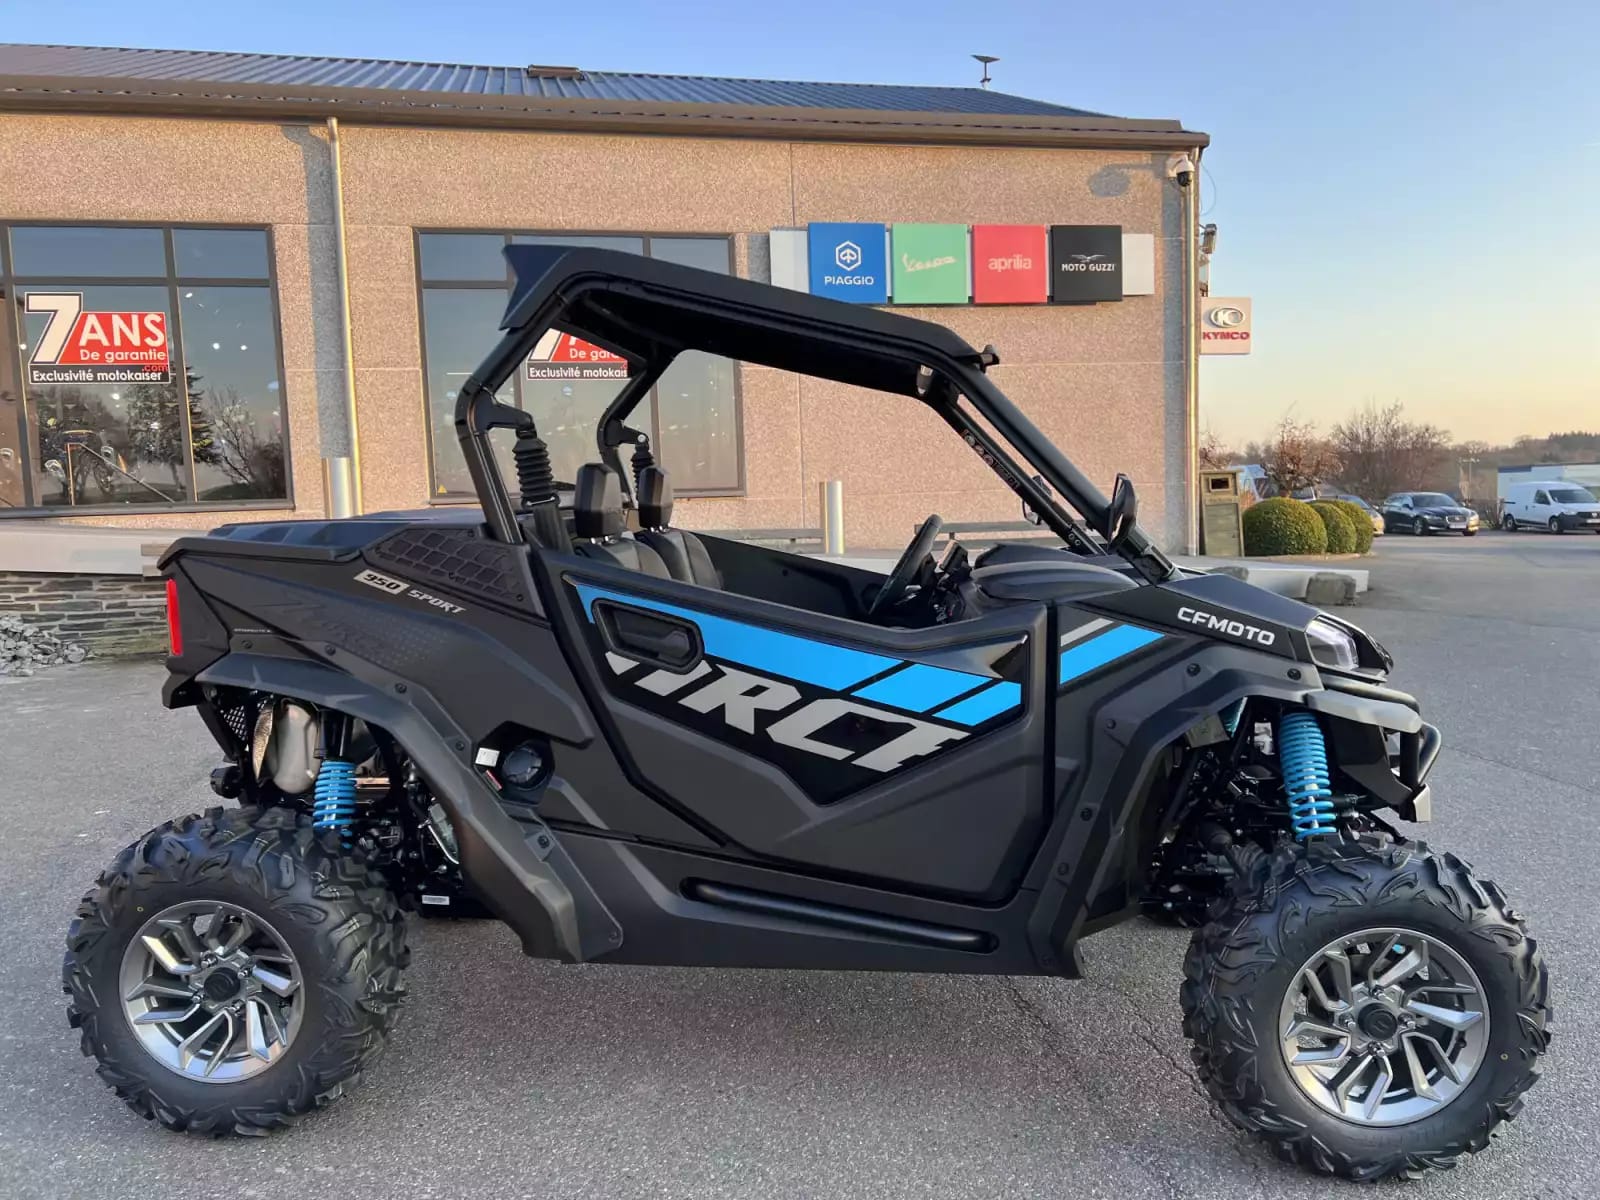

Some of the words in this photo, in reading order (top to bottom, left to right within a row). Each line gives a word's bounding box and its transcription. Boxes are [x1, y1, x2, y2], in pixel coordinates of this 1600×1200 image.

[902, 253, 957, 273] Vespa
[988, 254, 1032, 272] aprilia
[1061, 263, 1087, 272] MOTO
[1088, 263, 1115, 272] GUZZI
[824, 275, 874, 286] PIAGGIO
[26, 293, 82, 364] 7
[79, 314, 165, 347] ANS
[1202, 331, 1250, 340] KYMCO
[80, 350, 100, 360] De
[105, 349, 166, 363] garantie
[569, 348, 586, 359] De
[32, 369, 94, 382] Exclusivité
[97, 370, 162, 381] motokaiser
[529, 366, 580, 378] Exclusivité
[363, 573, 401, 590] 950
[407, 589, 467, 614] SPORT
[1177, 606, 1275, 646] CFMOTO
